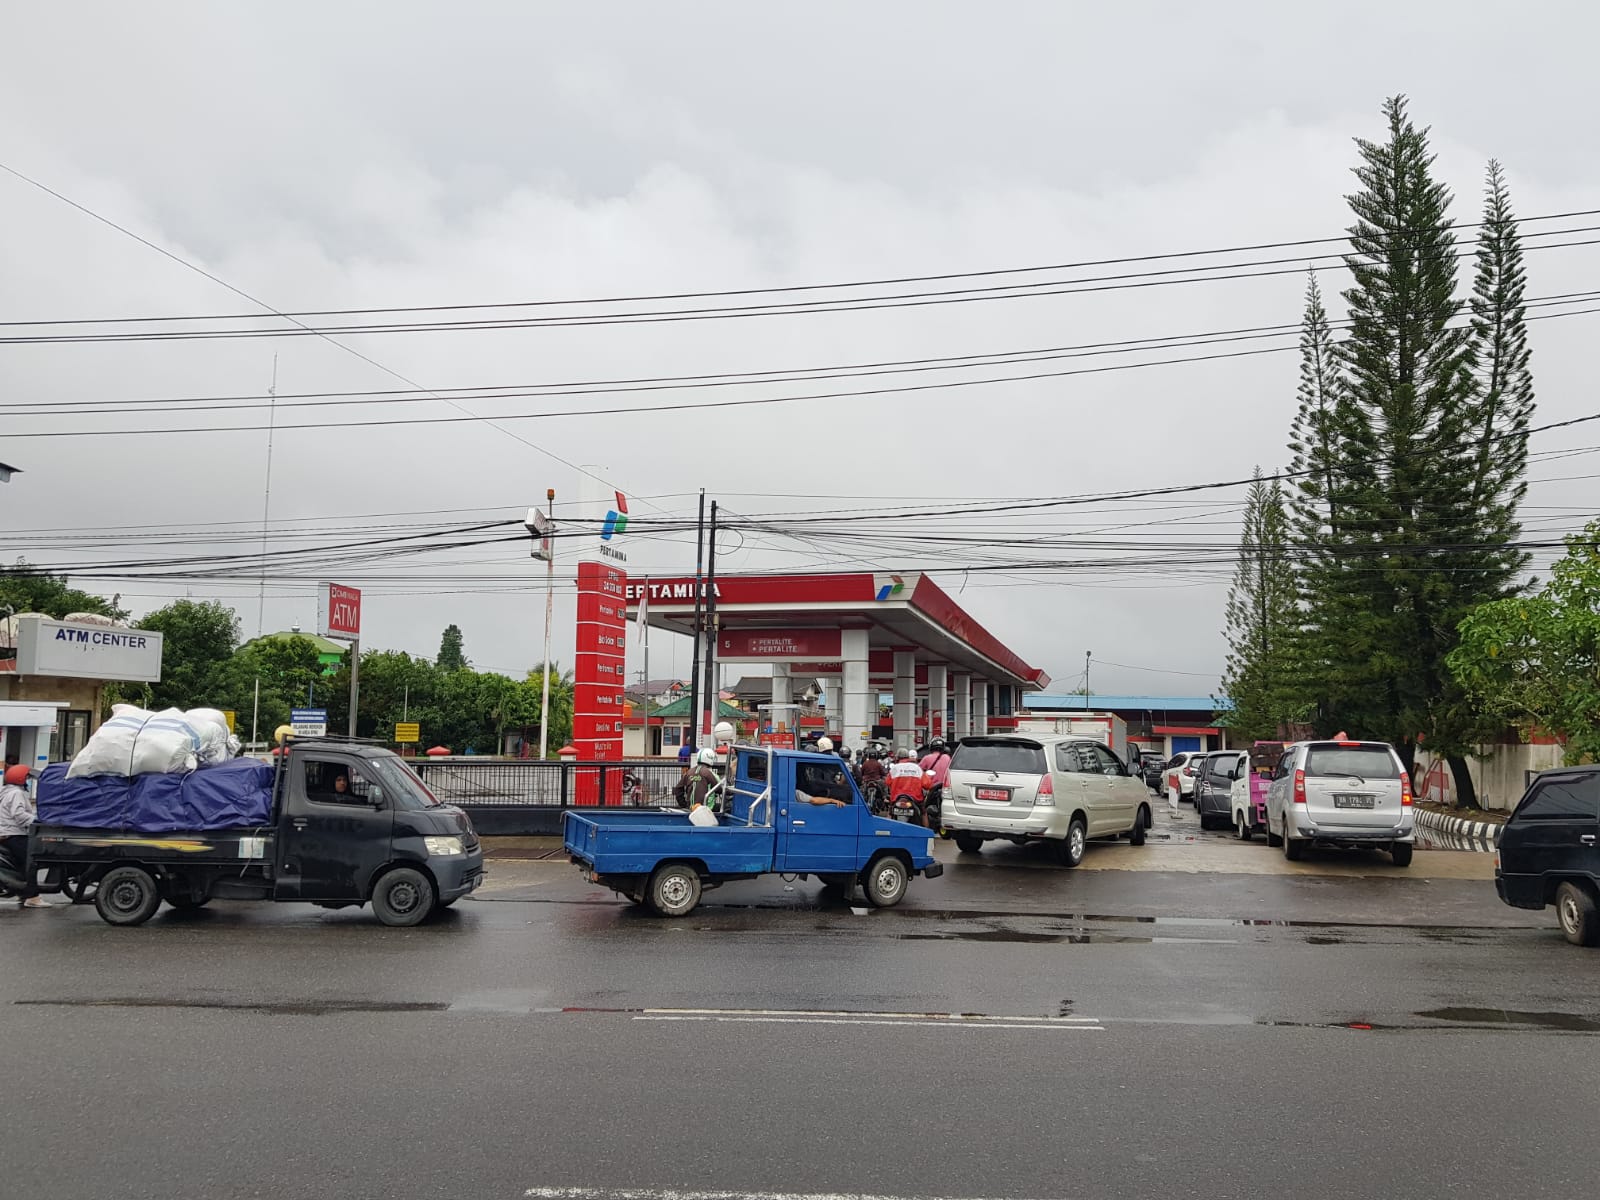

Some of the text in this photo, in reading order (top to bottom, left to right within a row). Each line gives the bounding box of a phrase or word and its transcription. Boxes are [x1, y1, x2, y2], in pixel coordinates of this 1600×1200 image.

[600, 545, 627, 562] PERTAMINA
[332, 603, 357, 629] ATM
[55, 628, 147, 649] ATM CENTER
[725, 640, 731, 648] 5
[759, 645, 798, 653] PERTALITE
